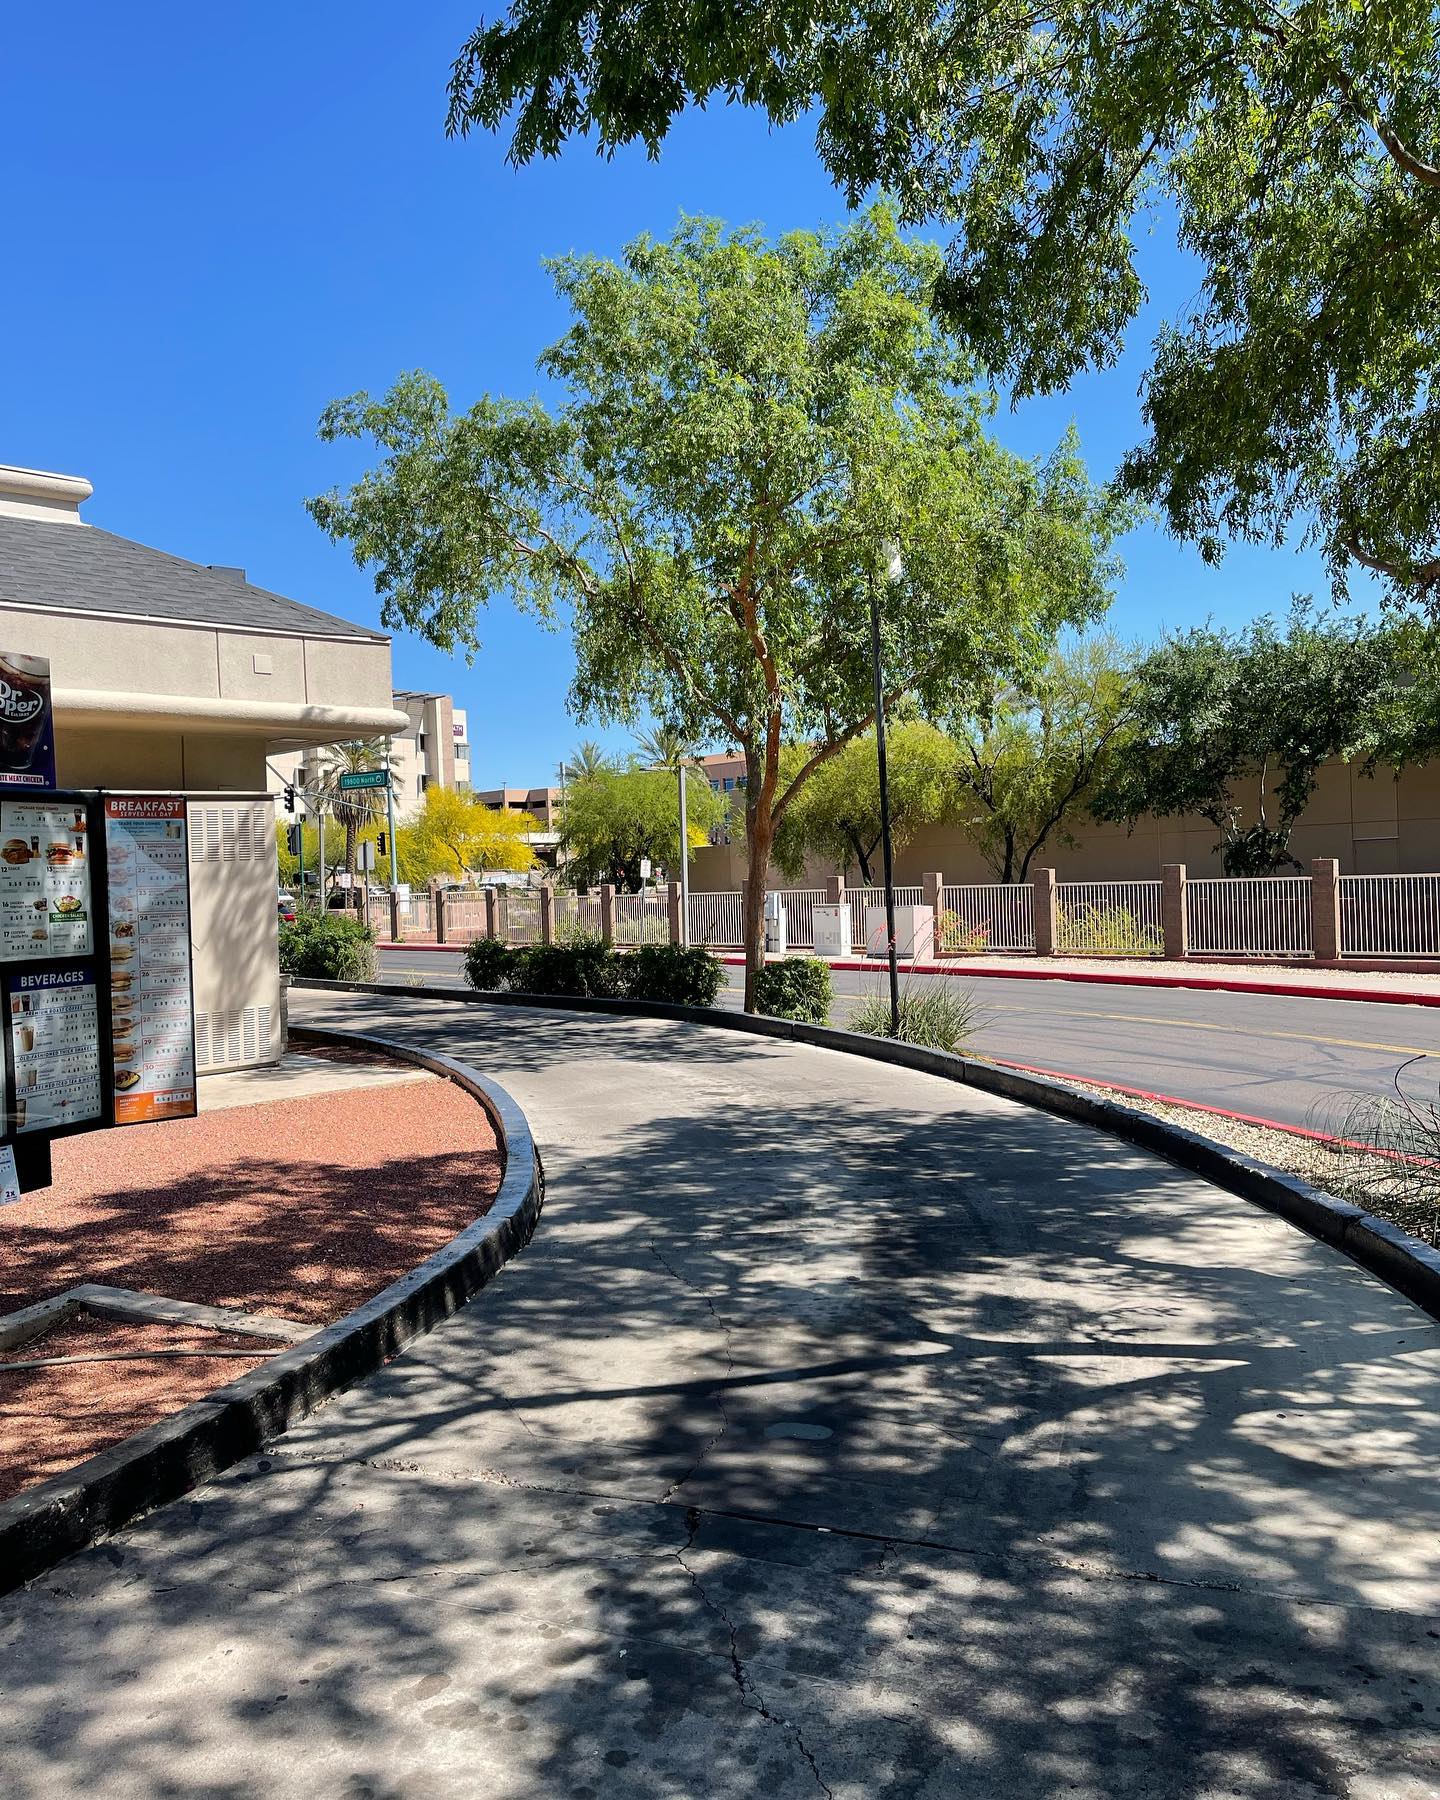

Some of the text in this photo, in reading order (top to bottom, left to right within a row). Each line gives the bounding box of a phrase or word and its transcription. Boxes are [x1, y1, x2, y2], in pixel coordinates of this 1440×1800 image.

[361, 776, 375, 784] North
[111, 801, 180, 811] BREAKFAST
[20, 971, 84, 987] BEVERAGES
